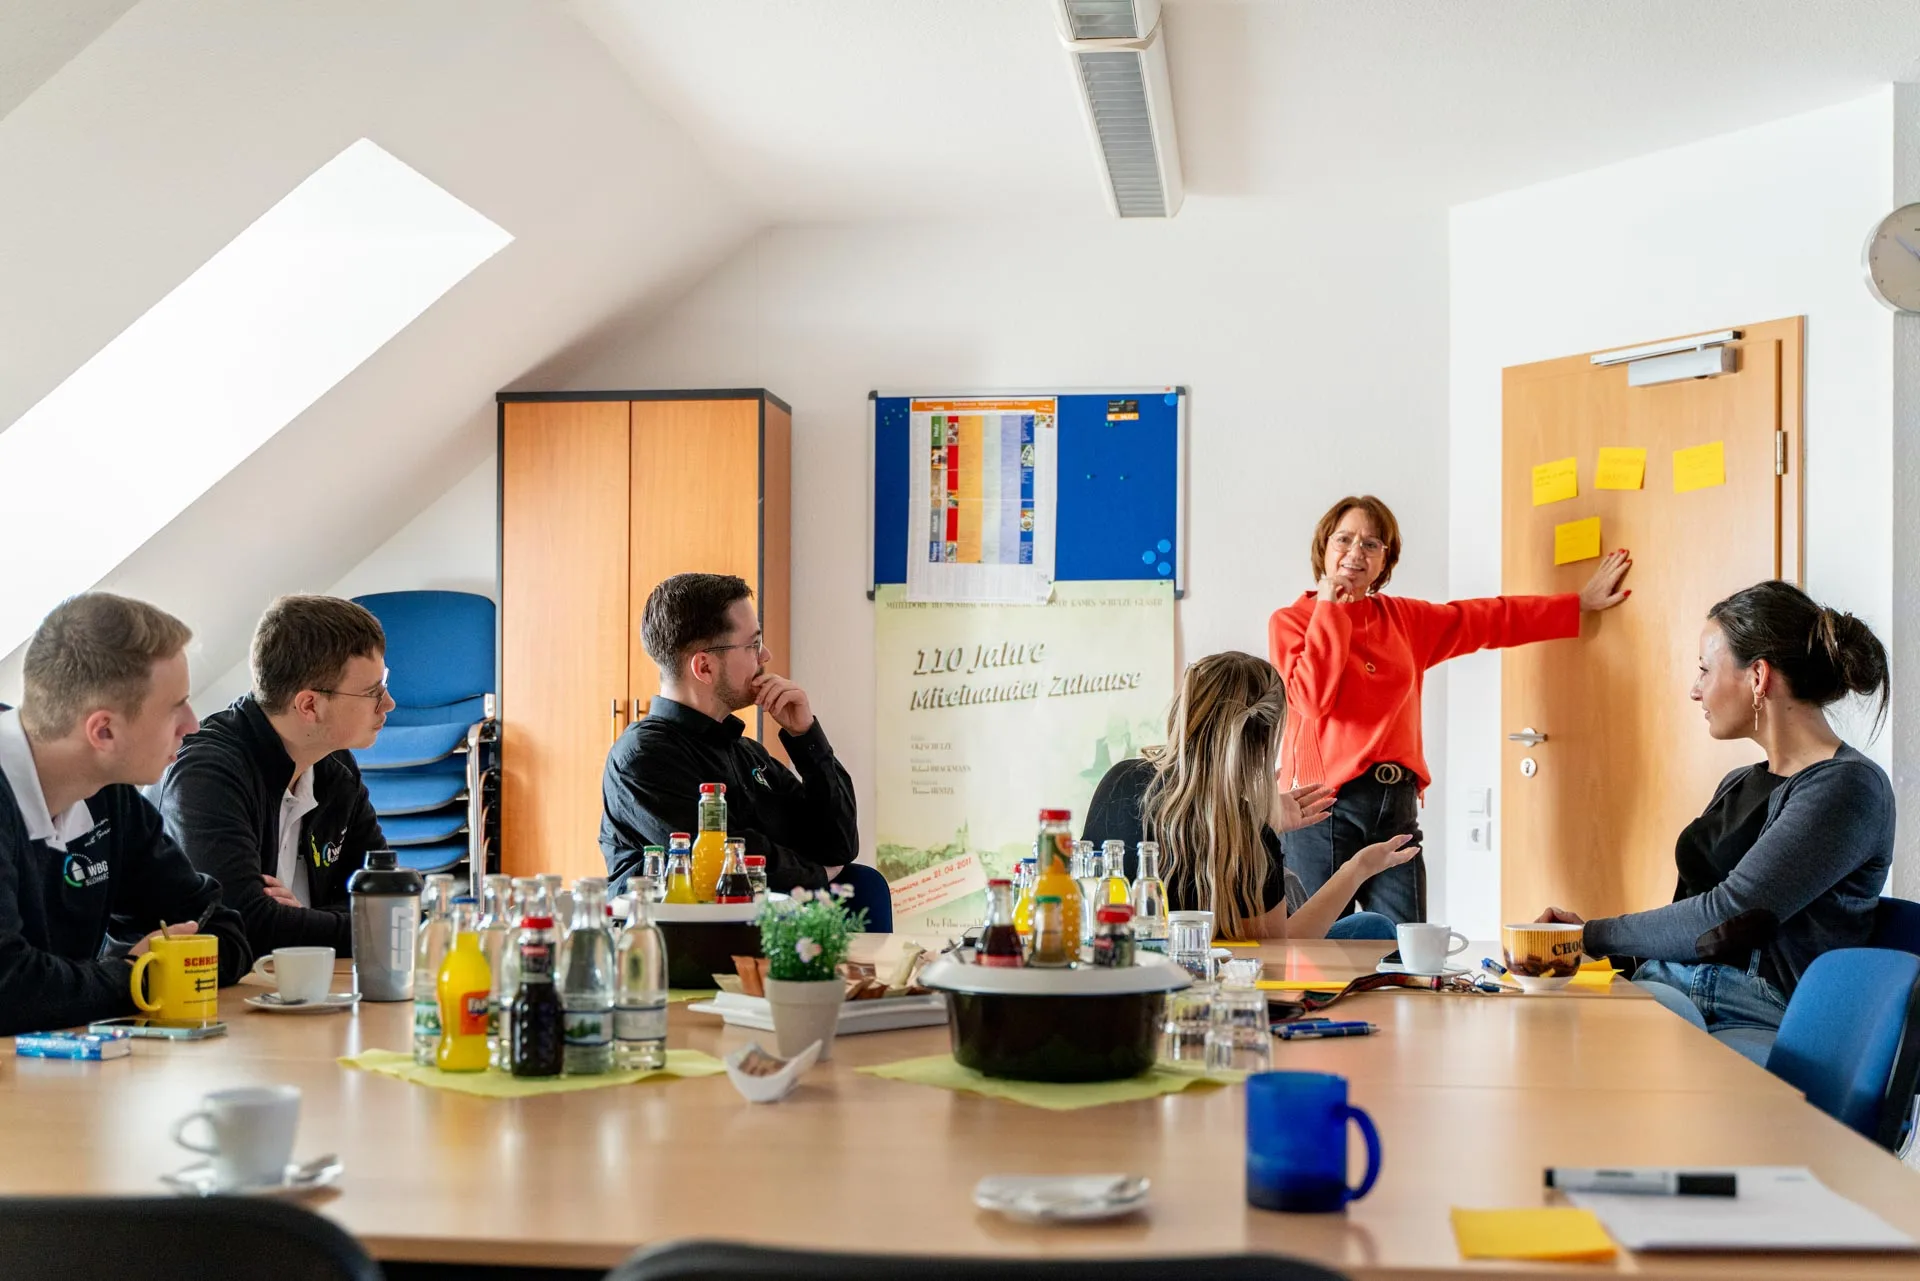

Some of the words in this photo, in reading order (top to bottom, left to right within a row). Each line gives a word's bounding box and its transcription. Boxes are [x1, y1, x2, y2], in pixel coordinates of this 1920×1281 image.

[913, 646, 963, 675] 110
[966, 641, 1046, 674] Jahre
[910, 680, 1041, 711] Miteinander
[1048, 672, 1141, 697] Zuhause
[87, 860, 109, 877] WBG
